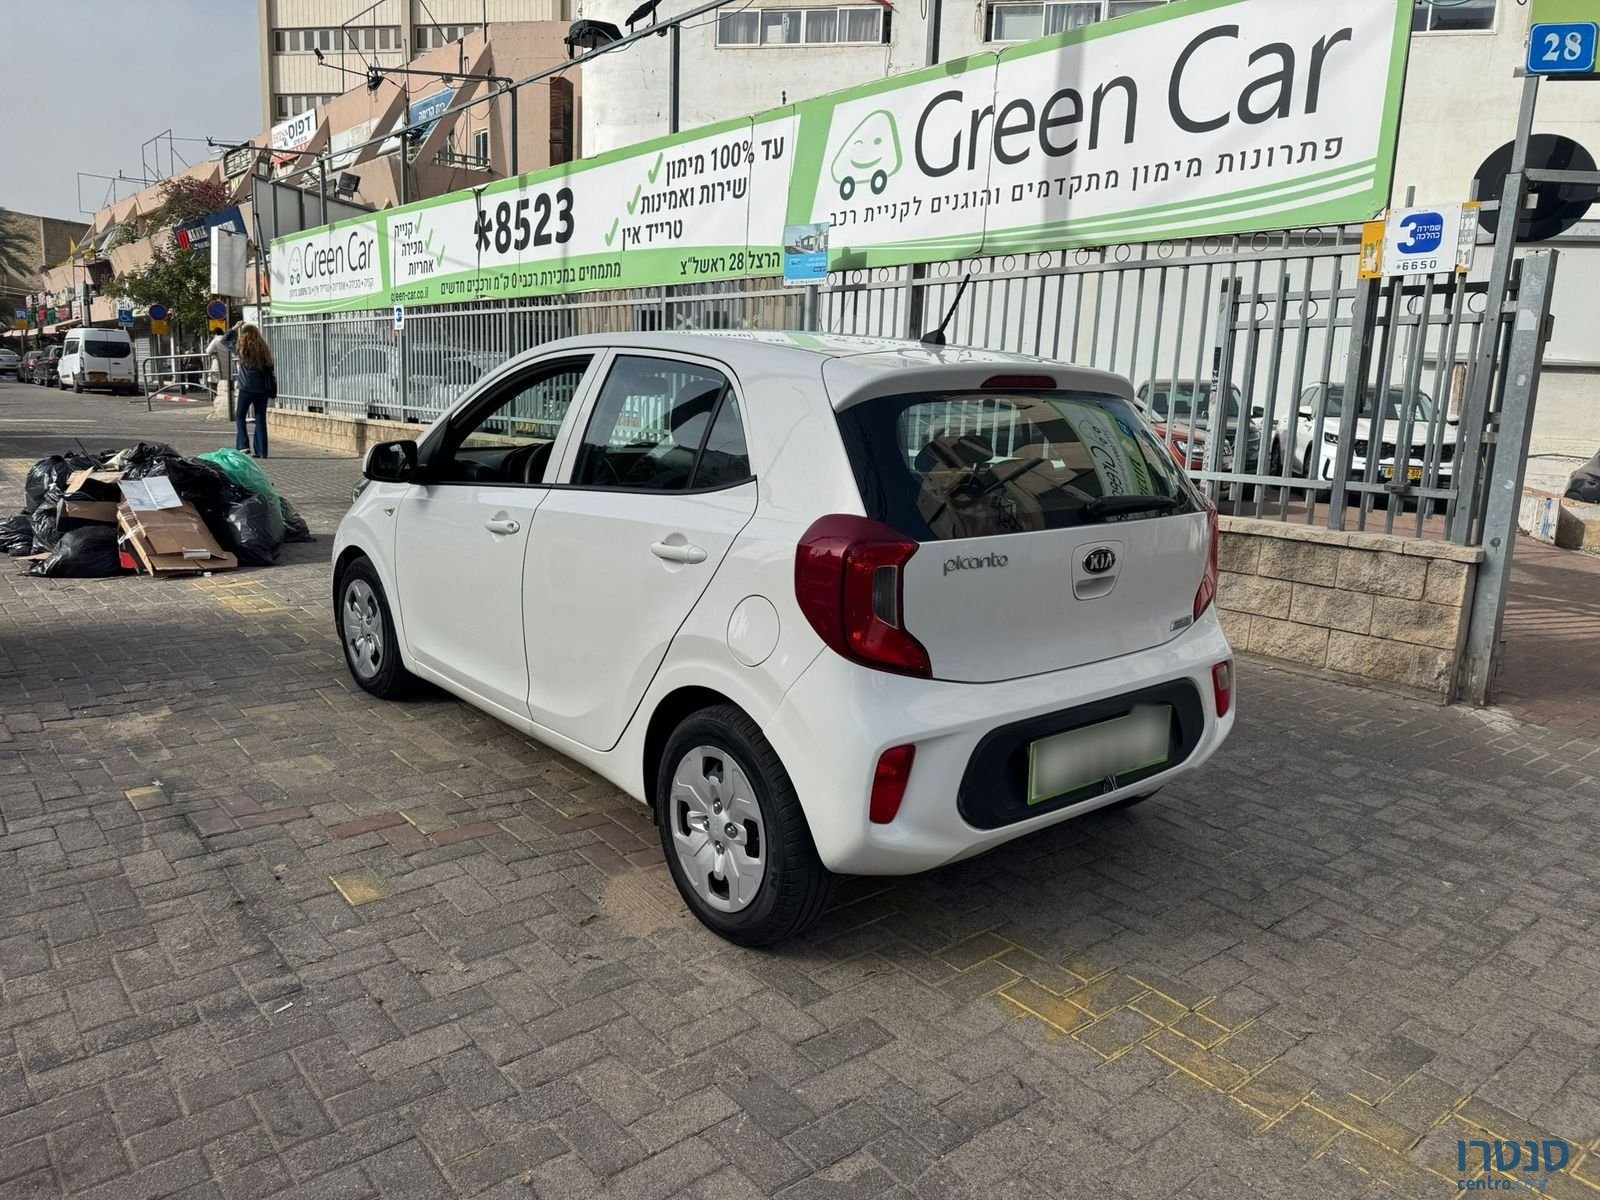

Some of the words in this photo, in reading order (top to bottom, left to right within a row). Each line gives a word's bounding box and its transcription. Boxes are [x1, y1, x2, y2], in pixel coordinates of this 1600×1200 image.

[1542, 31, 1582, 62] 28
[914, 75, 1138, 178] Green
[1167, 24, 1352, 134] Car
[288, 116, 310, 139] דפוס
[711, 140, 755, 171] 100%
[761, 136, 785, 161] עד
[1215, 136, 1344, 175] פתרונות
[666, 153, 704, 187] מימון
[1131, 157, 1202, 191] מימון
[699, 177, 748, 205] שירות
[1010, 169, 1120, 203] מתקדמים
[640, 187, 695, 215] ואמינות
[863, 196, 922, 223] לקניית
[930, 187, 1000, 214] והוגנים
[394, 222, 413, 239] קנייה
[645, 219, 683, 242] טרייד
[829, 209, 857, 228] רכב
[1416, 224, 1442, 233] שמירה
[401, 240, 423, 256] מכירה
[622, 225, 641, 251] אין
[304, 242, 344, 279] Green
[347, 231, 374, 271] Car
[729, 252, 745, 271] 28
[748, 250, 781, 270] הרצל
[408, 259, 434, 276] אחריות
[540, 268, 576, 286] במכירת
[579, 262, 621, 281] מתמחים
[440, 280, 465, 295] חדשים
[466, 278, 492, 294] ורכבים
[519, 274, 538, 288] רכבי
[943, 552, 1009, 577] picanto
[1089, 552, 1113, 570] KIA
